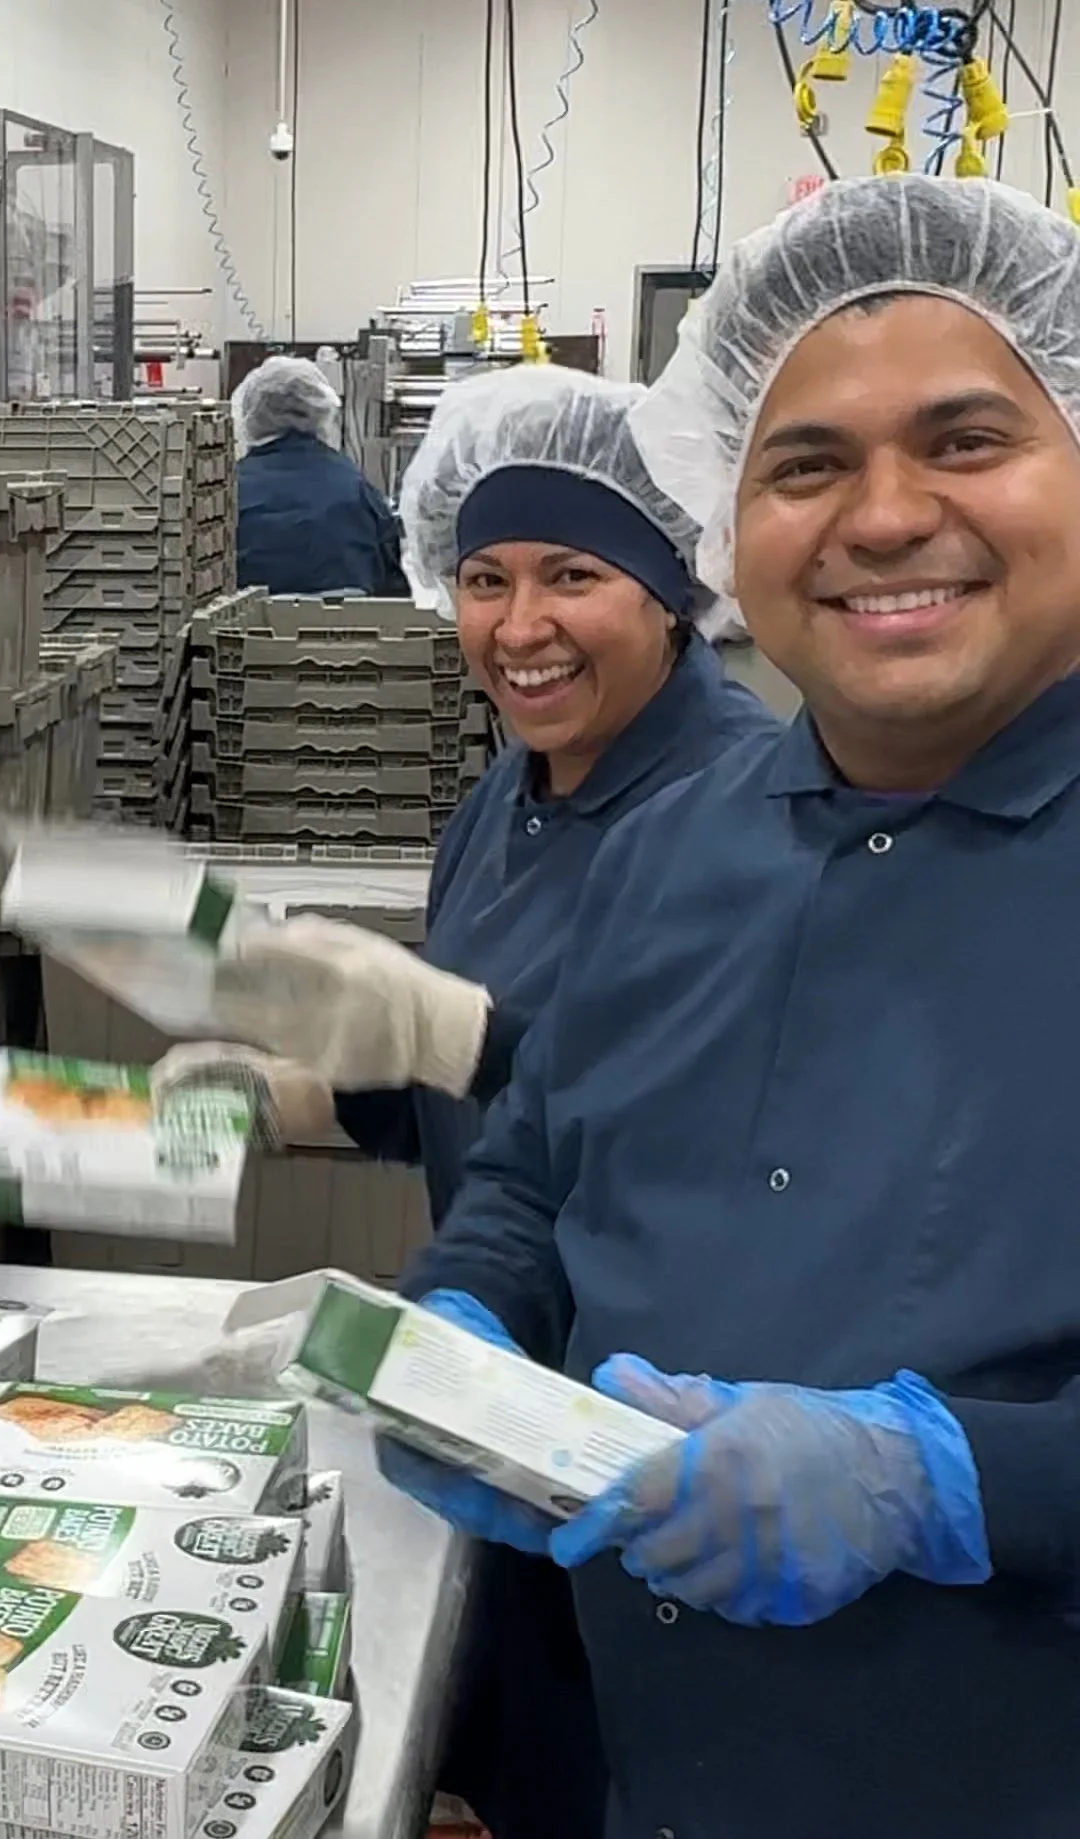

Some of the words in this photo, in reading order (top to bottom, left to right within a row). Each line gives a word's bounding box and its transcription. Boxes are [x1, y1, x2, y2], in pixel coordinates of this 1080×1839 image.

[169, 1430, 270, 1454] POTATO
[184, 1420, 266, 1440] BAKES
[0, 1588, 68, 1638] POTATO
[127, 1613, 181, 1659] GREAT
